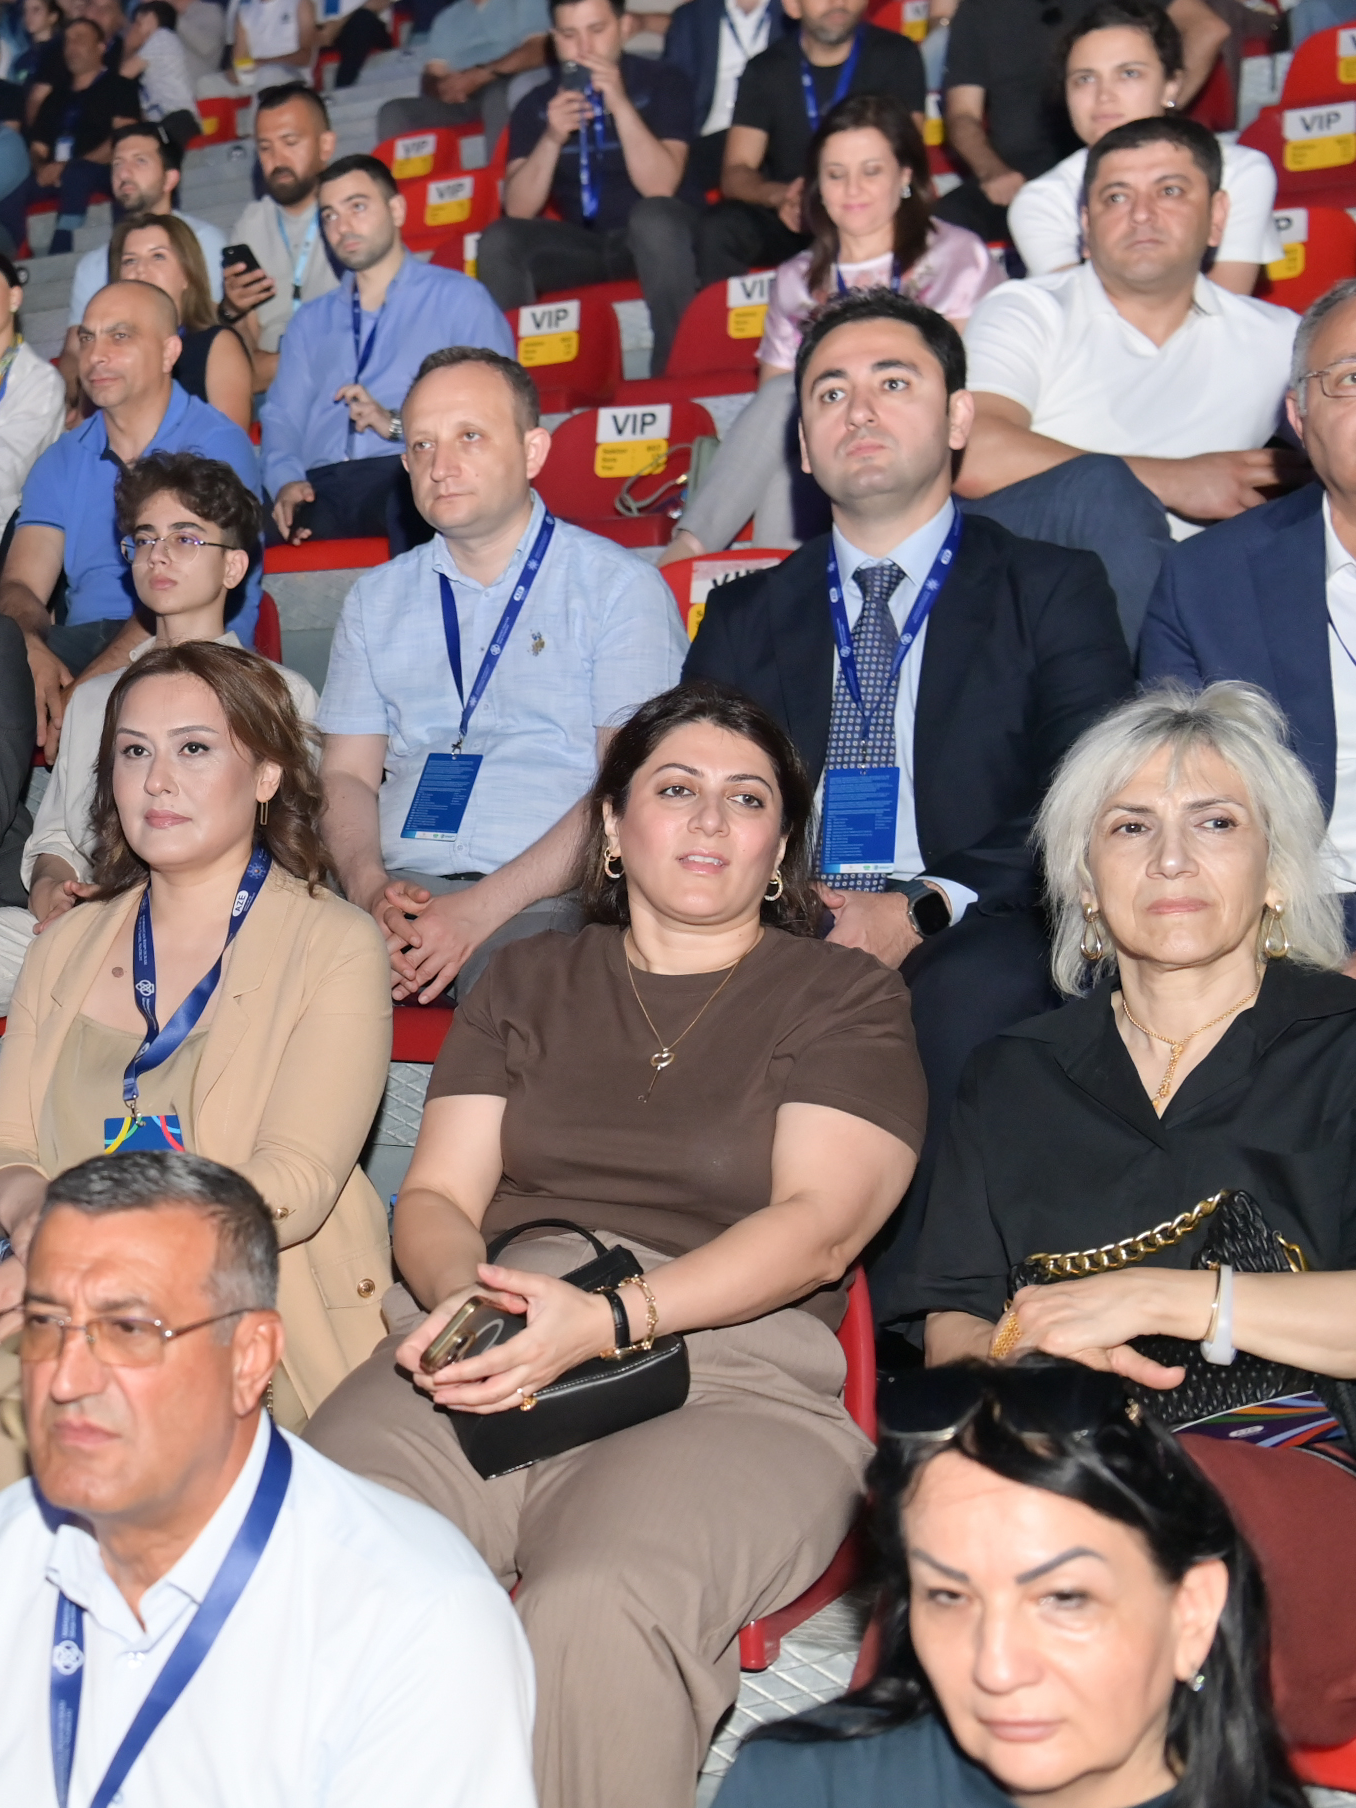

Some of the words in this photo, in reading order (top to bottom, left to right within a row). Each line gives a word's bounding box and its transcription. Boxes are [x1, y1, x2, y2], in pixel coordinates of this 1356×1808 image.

[1301, 112, 1341, 132] VIP
[531, 309, 568, 330] VIP
[612, 413, 656, 435] VIP
[235, 894, 246, 912] AZE
